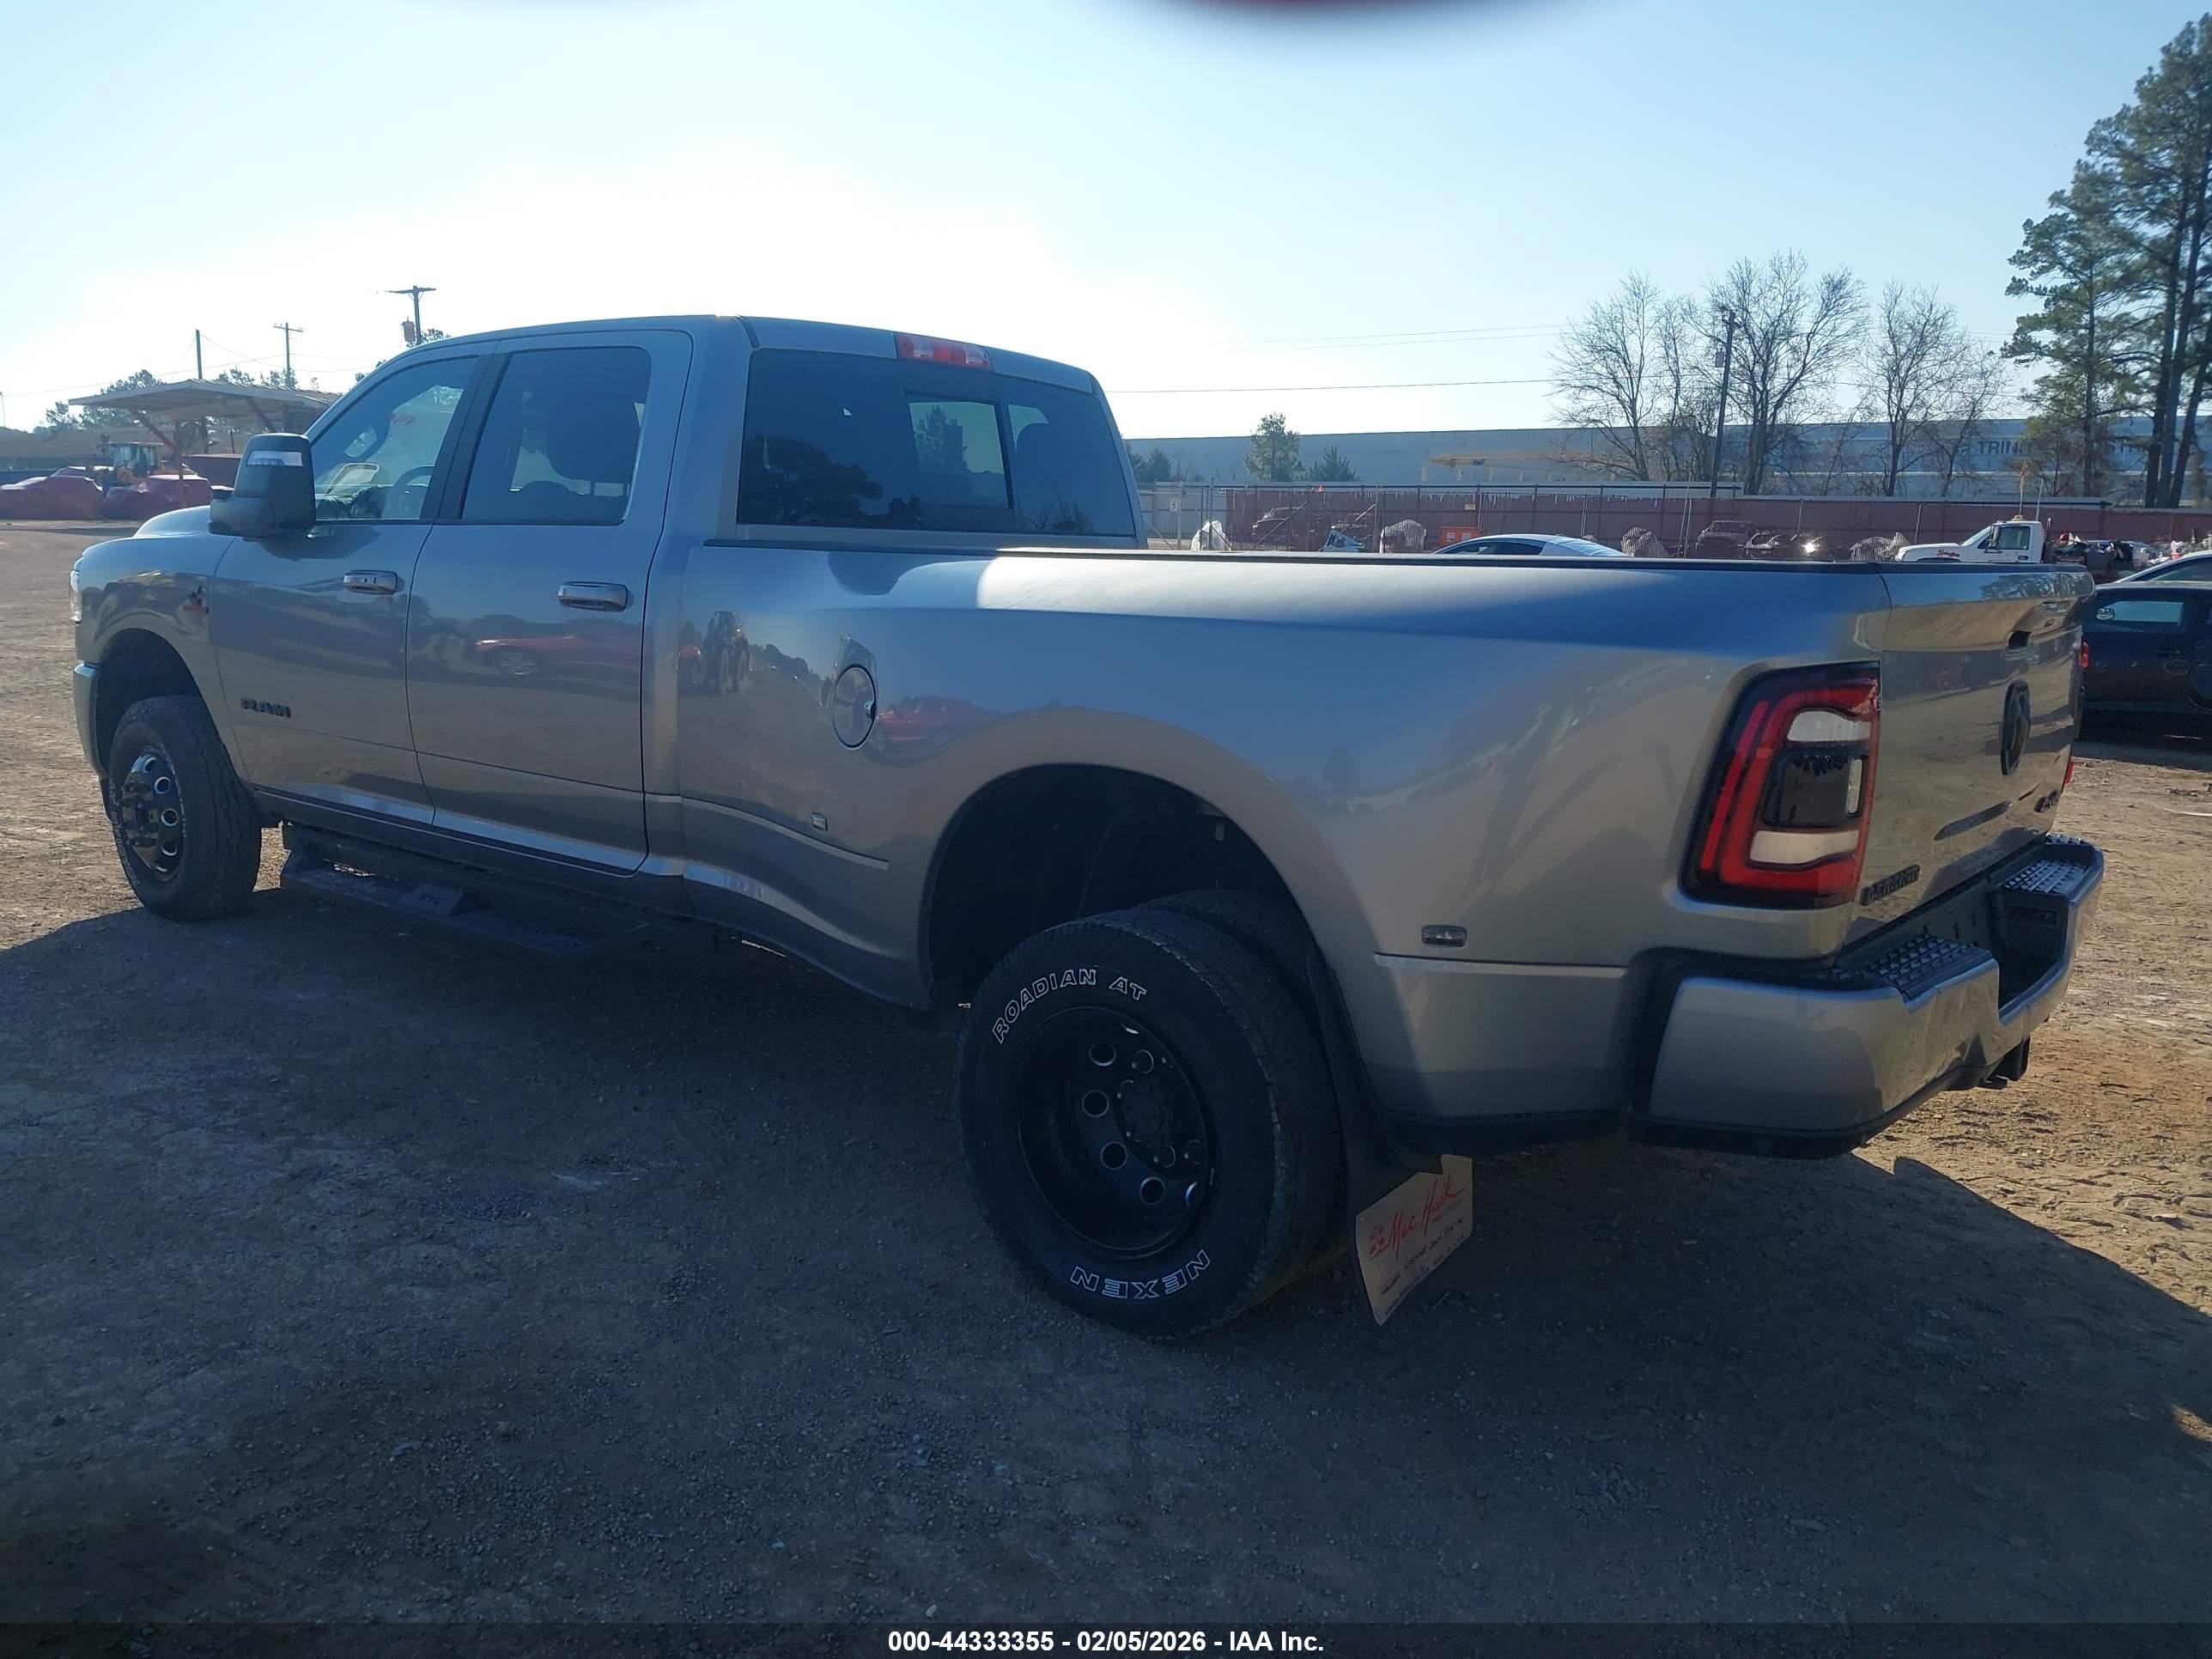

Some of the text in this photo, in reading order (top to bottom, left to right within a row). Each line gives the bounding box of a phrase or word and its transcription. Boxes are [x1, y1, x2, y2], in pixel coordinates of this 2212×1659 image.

[992, 968, 1147, 1044] ROADIAN AT
[1069, 1249, 1211, 1300] NEXEN
